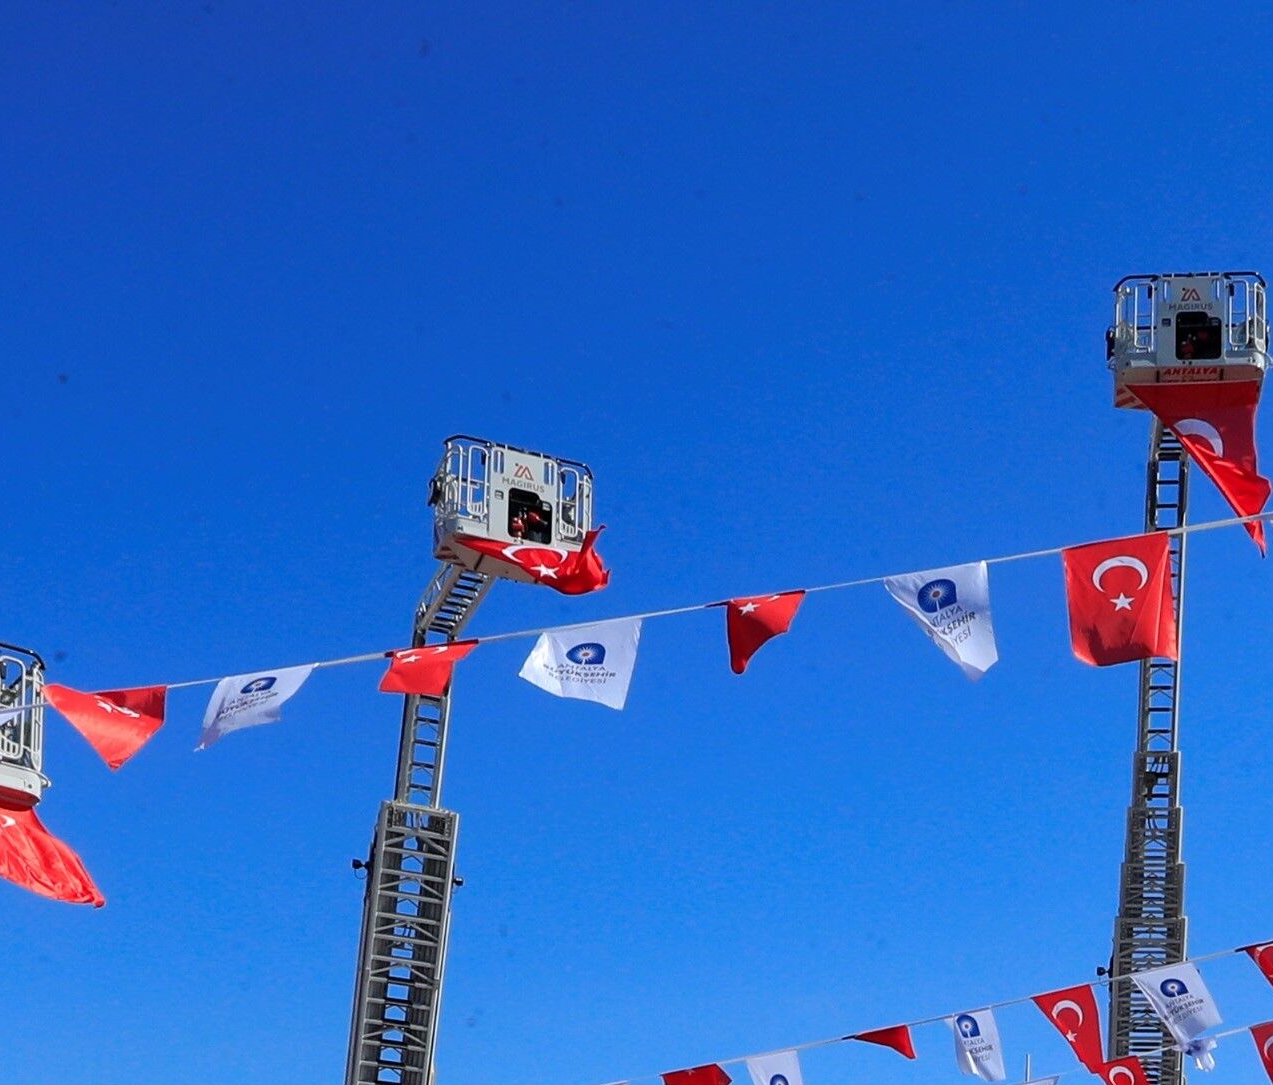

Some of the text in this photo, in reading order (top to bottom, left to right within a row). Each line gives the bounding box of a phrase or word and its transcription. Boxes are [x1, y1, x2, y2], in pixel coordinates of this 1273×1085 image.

[1169, 302, 1214, 311] MAGIRUS
[1164, 367, 1218, 376] ANTALYA
[502, 477, 545, 494] MAGIRUS
[930, 606, 964, 628] NTALYA
